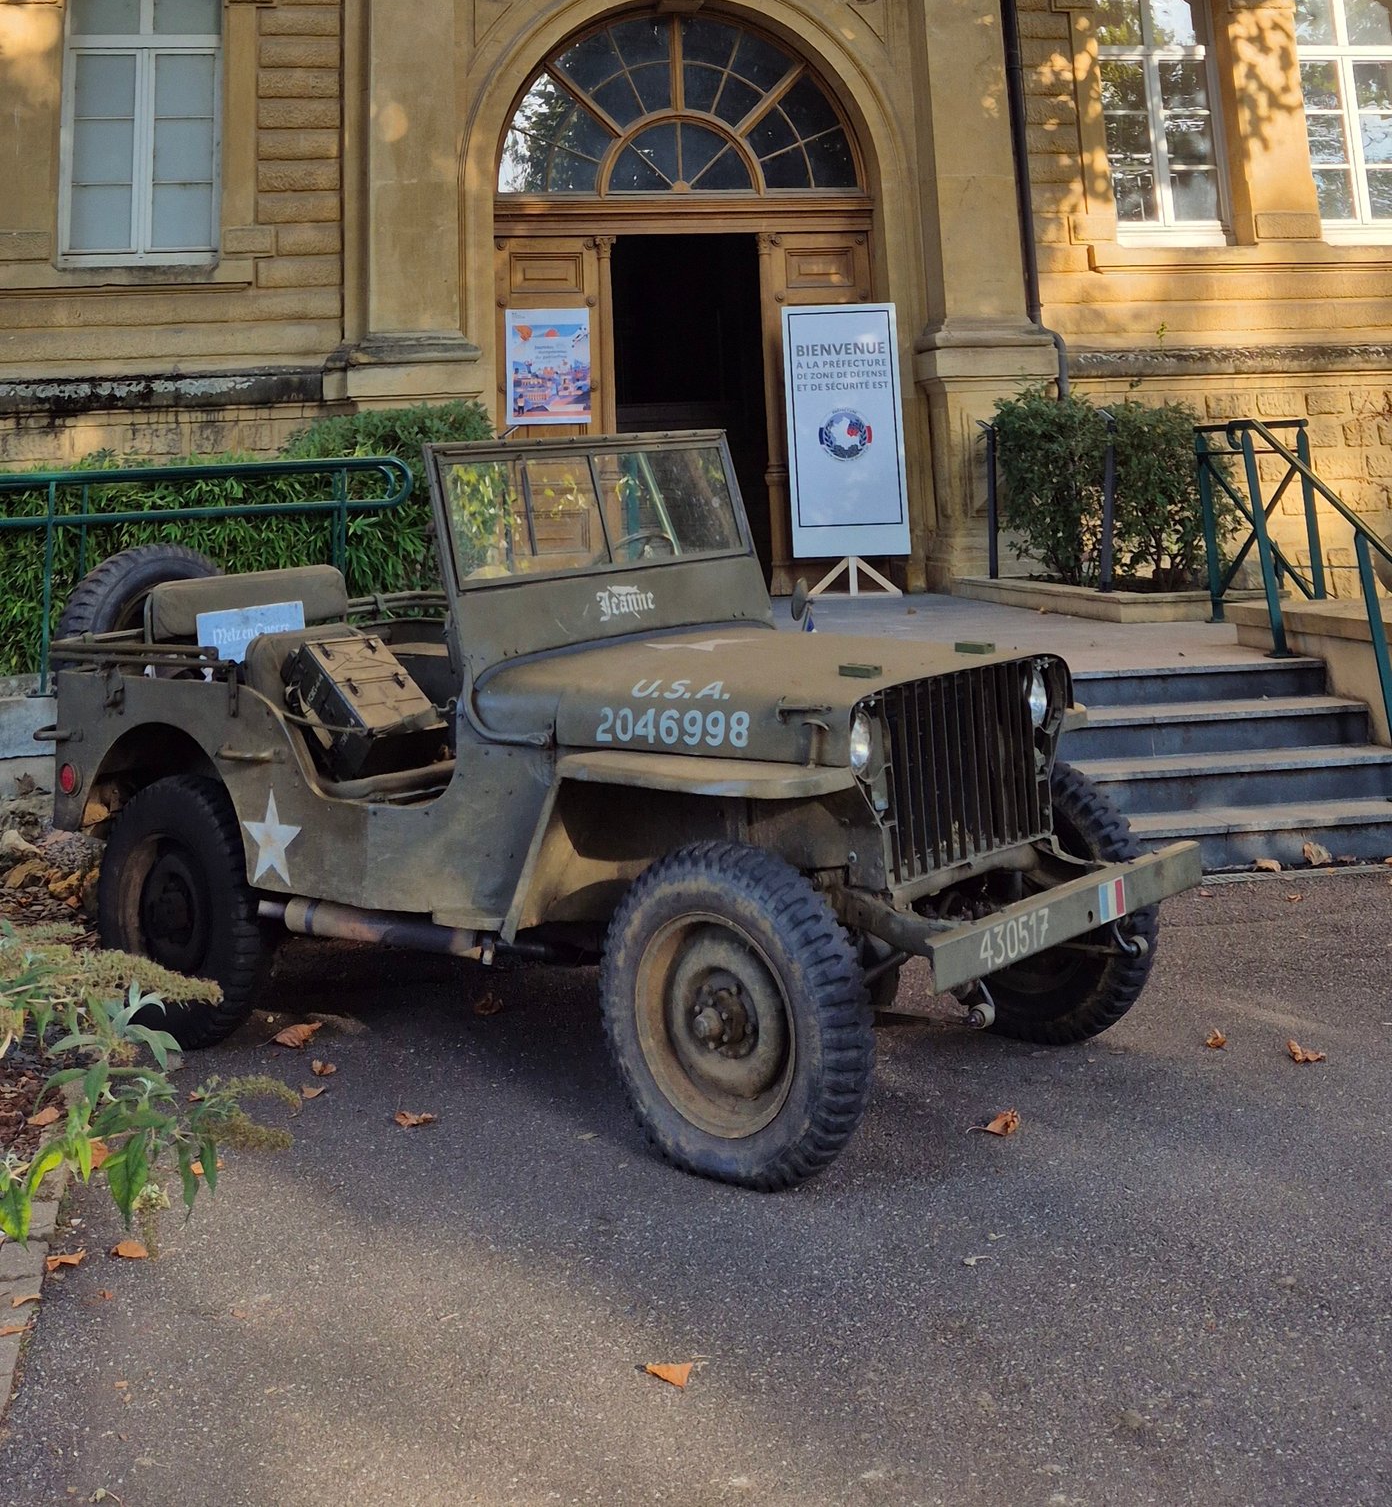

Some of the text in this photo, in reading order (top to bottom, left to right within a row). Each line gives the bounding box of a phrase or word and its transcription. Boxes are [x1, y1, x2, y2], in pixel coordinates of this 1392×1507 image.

[796, 342, 885, 357] BIENVENUE
[796, 358, 887, 369] À LA PRÉFECTURE
[810, 372, 835, 380] ZONE
[837, 371, 848, 379] DE
[850, 369, 887, 378] DÉFENSE
[811, 383, 823, 391] DE
[825, 380, 870, 391] SÉCURITÉ
[873, 381, 888, 389] EST
[596, 585, 656, 622] Jeanne
[631, 679, 730, 700] U.S.A.
[596, 706, 750, 748] 2046998
[979, 907, 1050, 970] 430517
